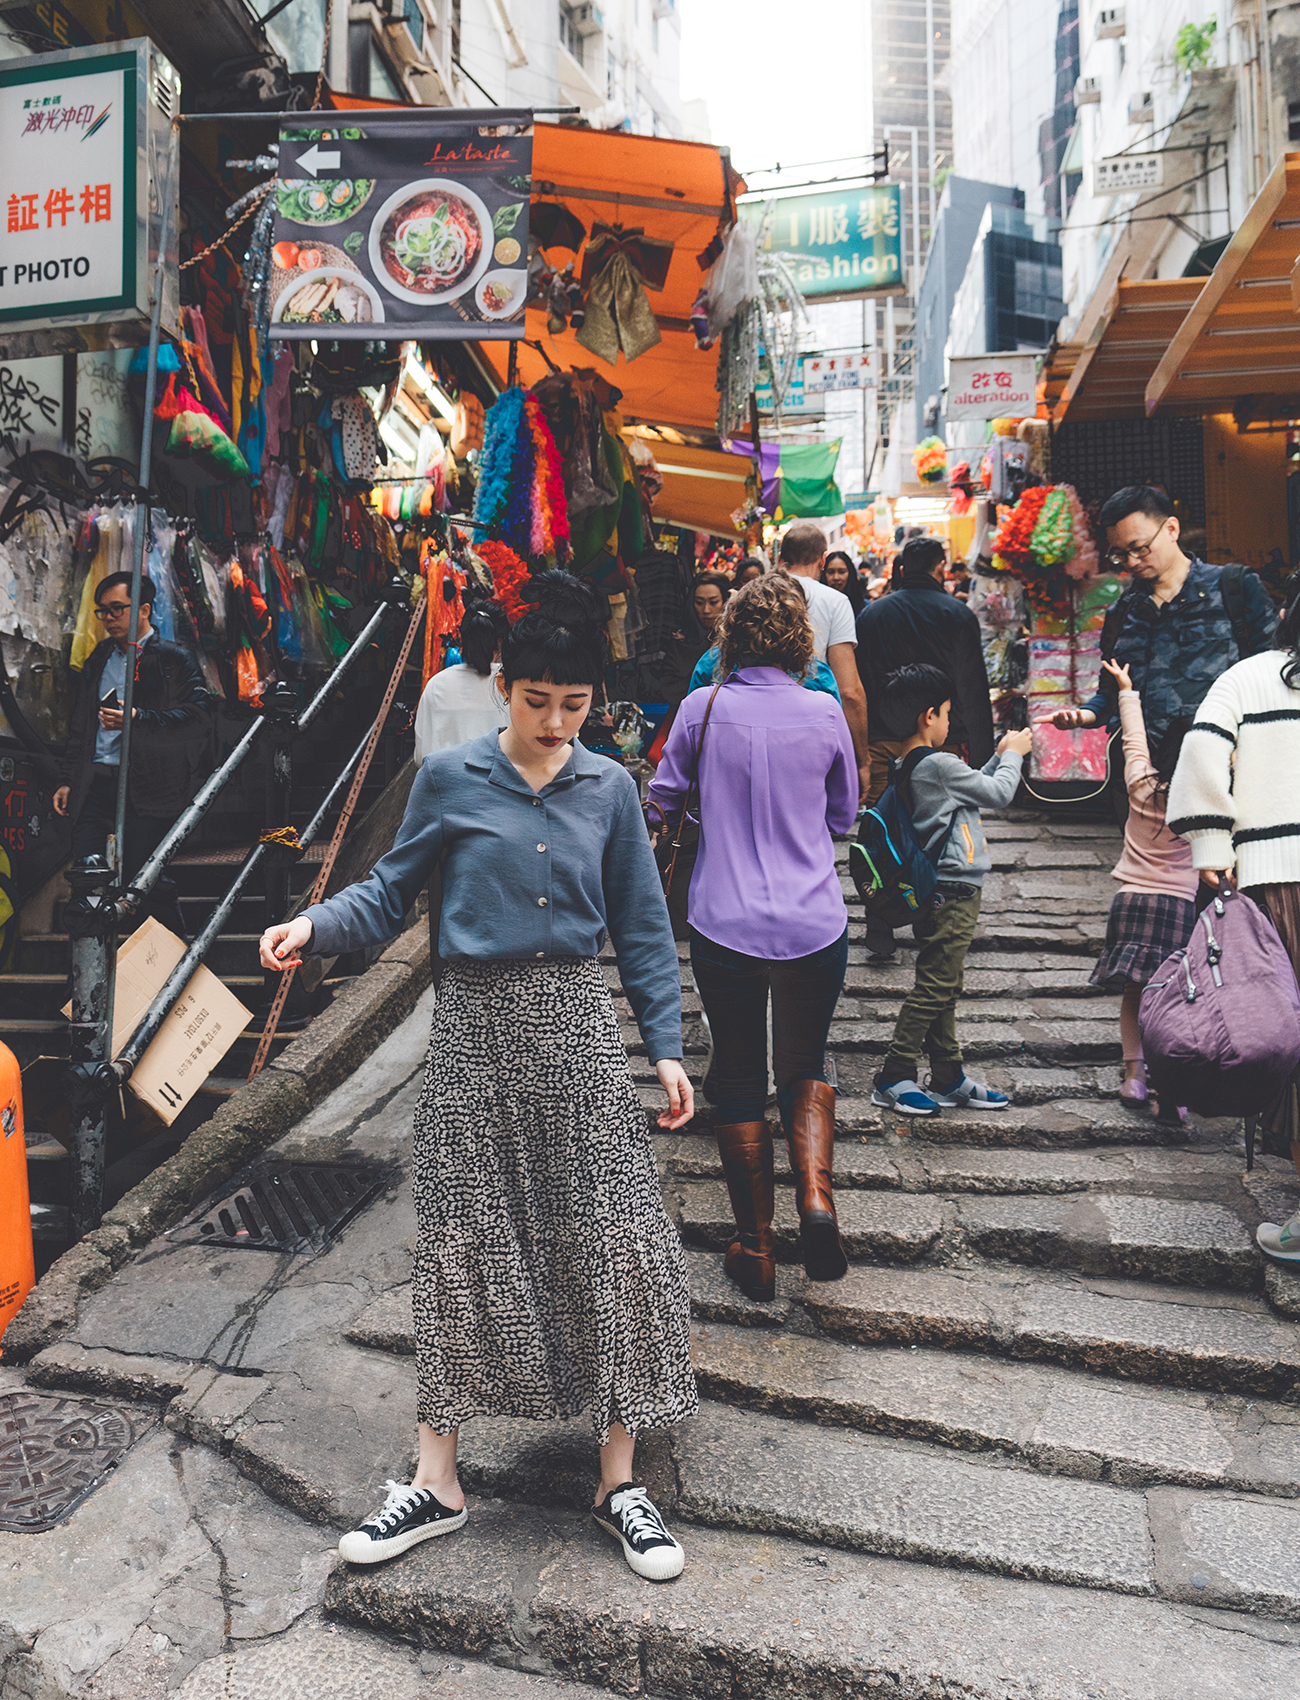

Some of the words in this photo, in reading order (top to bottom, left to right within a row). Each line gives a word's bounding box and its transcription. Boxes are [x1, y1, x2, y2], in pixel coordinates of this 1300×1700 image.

[7, 183, 111, 233] 証件相
[14, 256, 90, 284] PHOTO
[954, 390, 1029, 405] alteration
[174, 1004, 188, 1019] PCS
